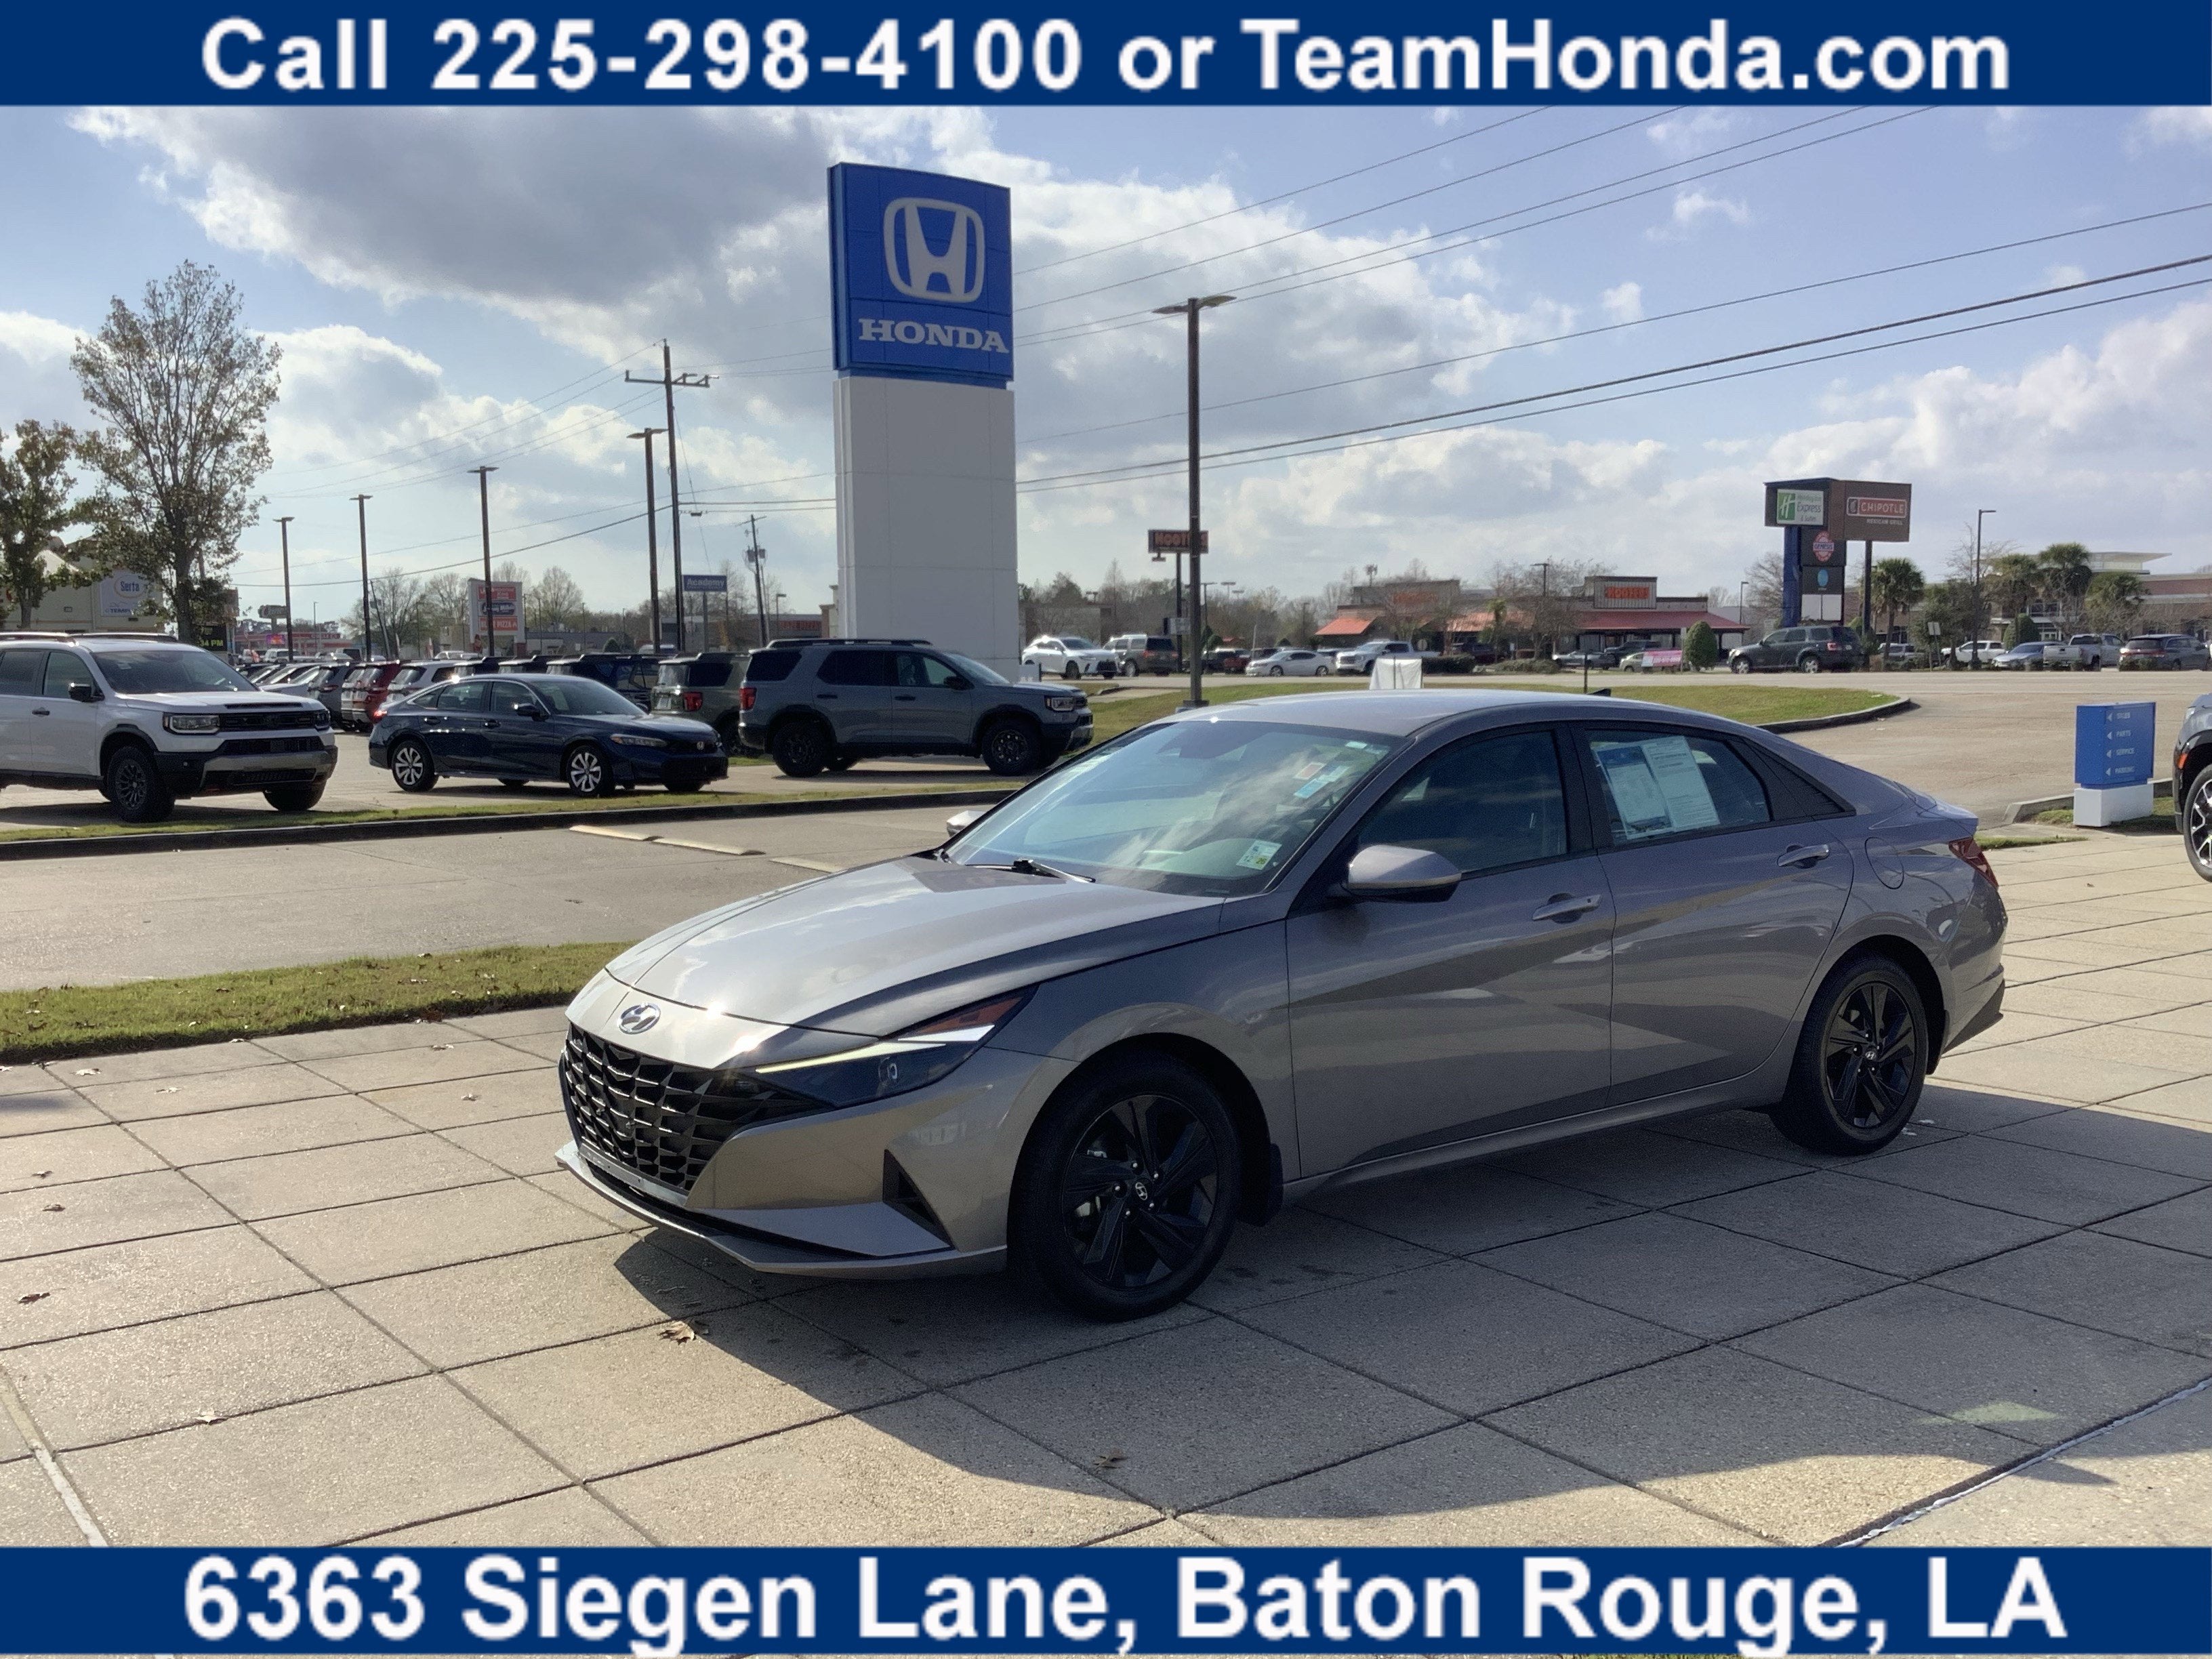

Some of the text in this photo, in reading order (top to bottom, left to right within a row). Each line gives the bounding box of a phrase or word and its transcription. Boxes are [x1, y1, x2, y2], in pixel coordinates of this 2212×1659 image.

[858, 319, 1009, 354] HONDA
[1797, 501, 1822, 513] Express
[1860, 502, 1904, 514] CHIPOTLE
[120, 581, 140, 592] Serta
[687, 578, 725, 588] Academy
